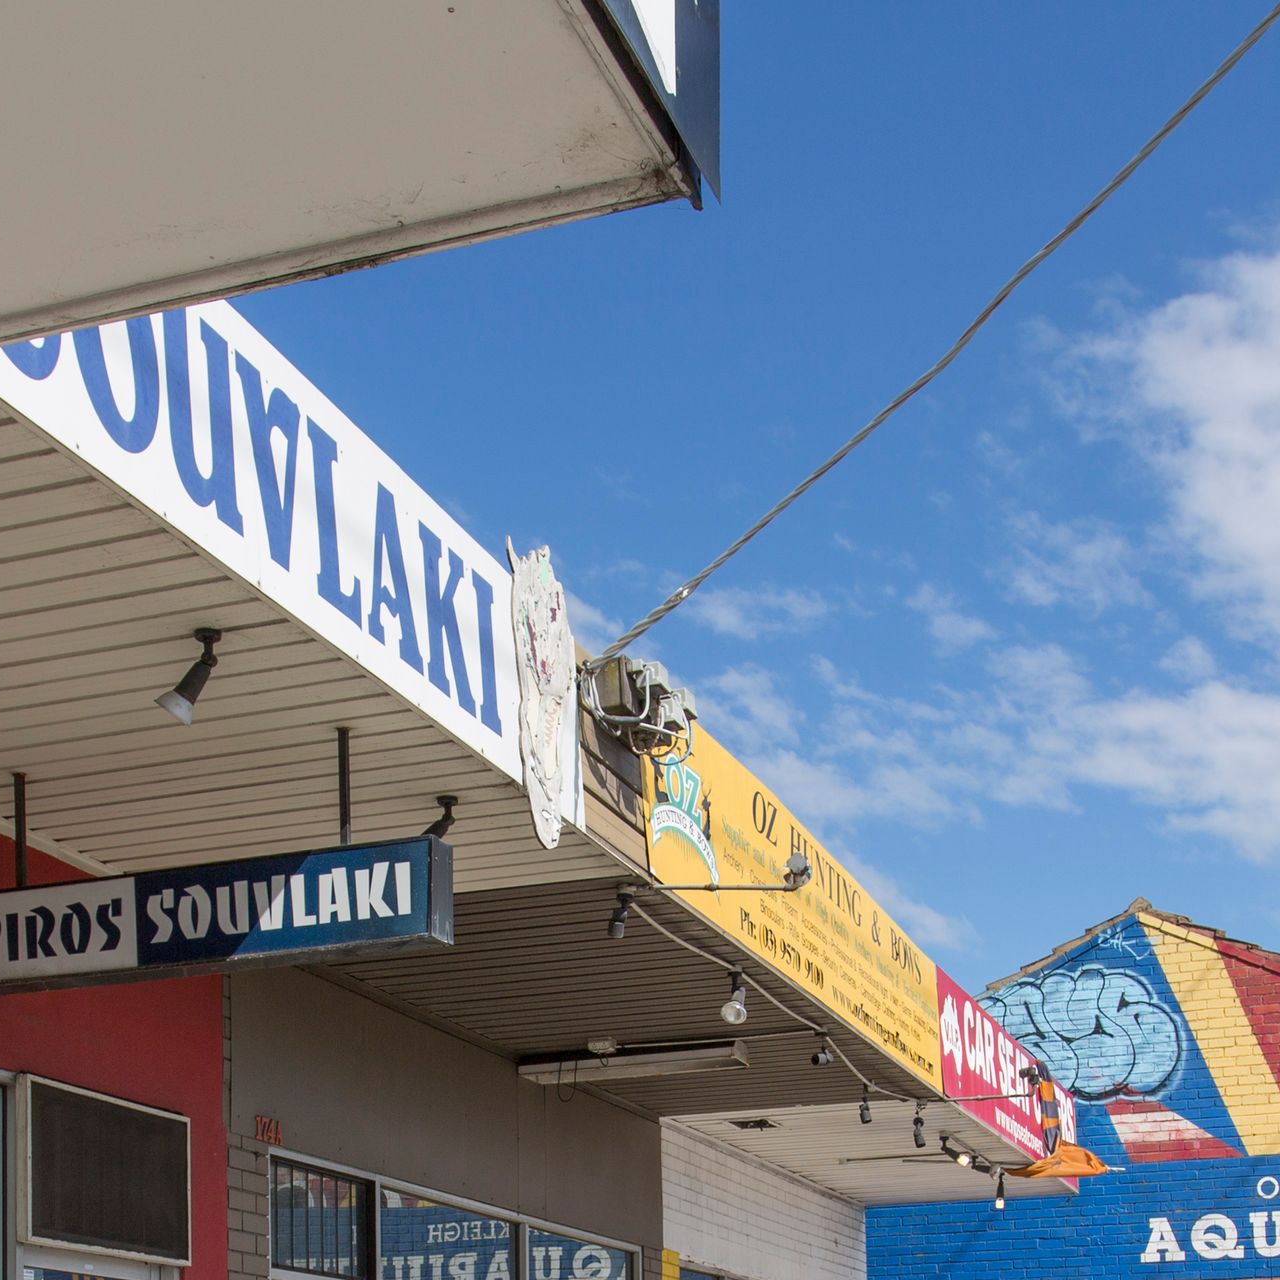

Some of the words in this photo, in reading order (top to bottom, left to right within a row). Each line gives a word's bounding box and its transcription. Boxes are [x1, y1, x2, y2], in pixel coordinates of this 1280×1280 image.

[0, 302, 503, 738] OUVLAKI
[664, 752, 703, 831] OZ
[146, 860, 412, 944] SOUVLAKI
[752, 790, 778, 847] OZ
[871, 910, 880, 947] &
[890, 927, 922, 985] BOWS
[739, 906, 757, 941] Ph:
[758, 919, 777, 963] (03)
[780, 937, 802, 973] 9570
[804, 958, 825, 991] 9100
[963, 1000, 998, 1089] CAR
[997, 1031, 1031, 1116] SEAT
[255, 1115, 284, 1146] 174A
